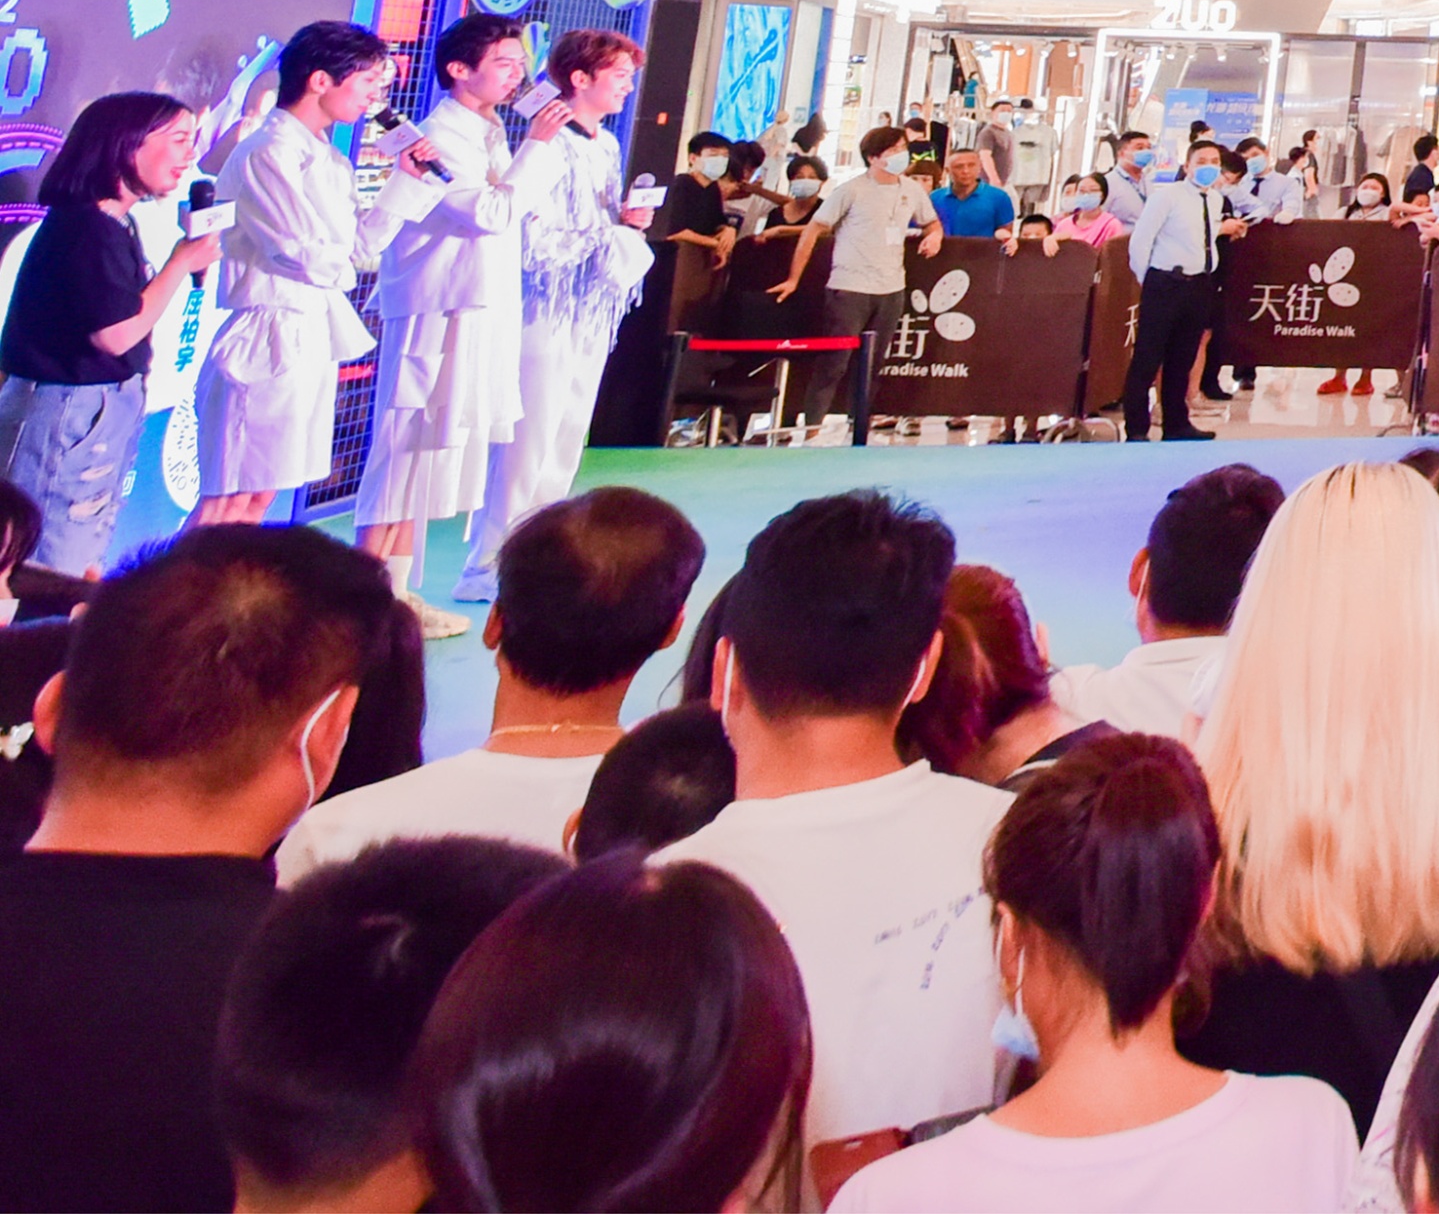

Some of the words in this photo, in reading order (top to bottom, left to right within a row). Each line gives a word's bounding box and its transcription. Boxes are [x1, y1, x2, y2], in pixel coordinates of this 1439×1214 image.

[1249, 283, 1323, 323] 天街
[1274, 324, 1324, 337] Paradise
[1326, 324, 1356, 337] Walk
[880, 362, 928, 377] radise
[931, 363, 969, 378] Walk
